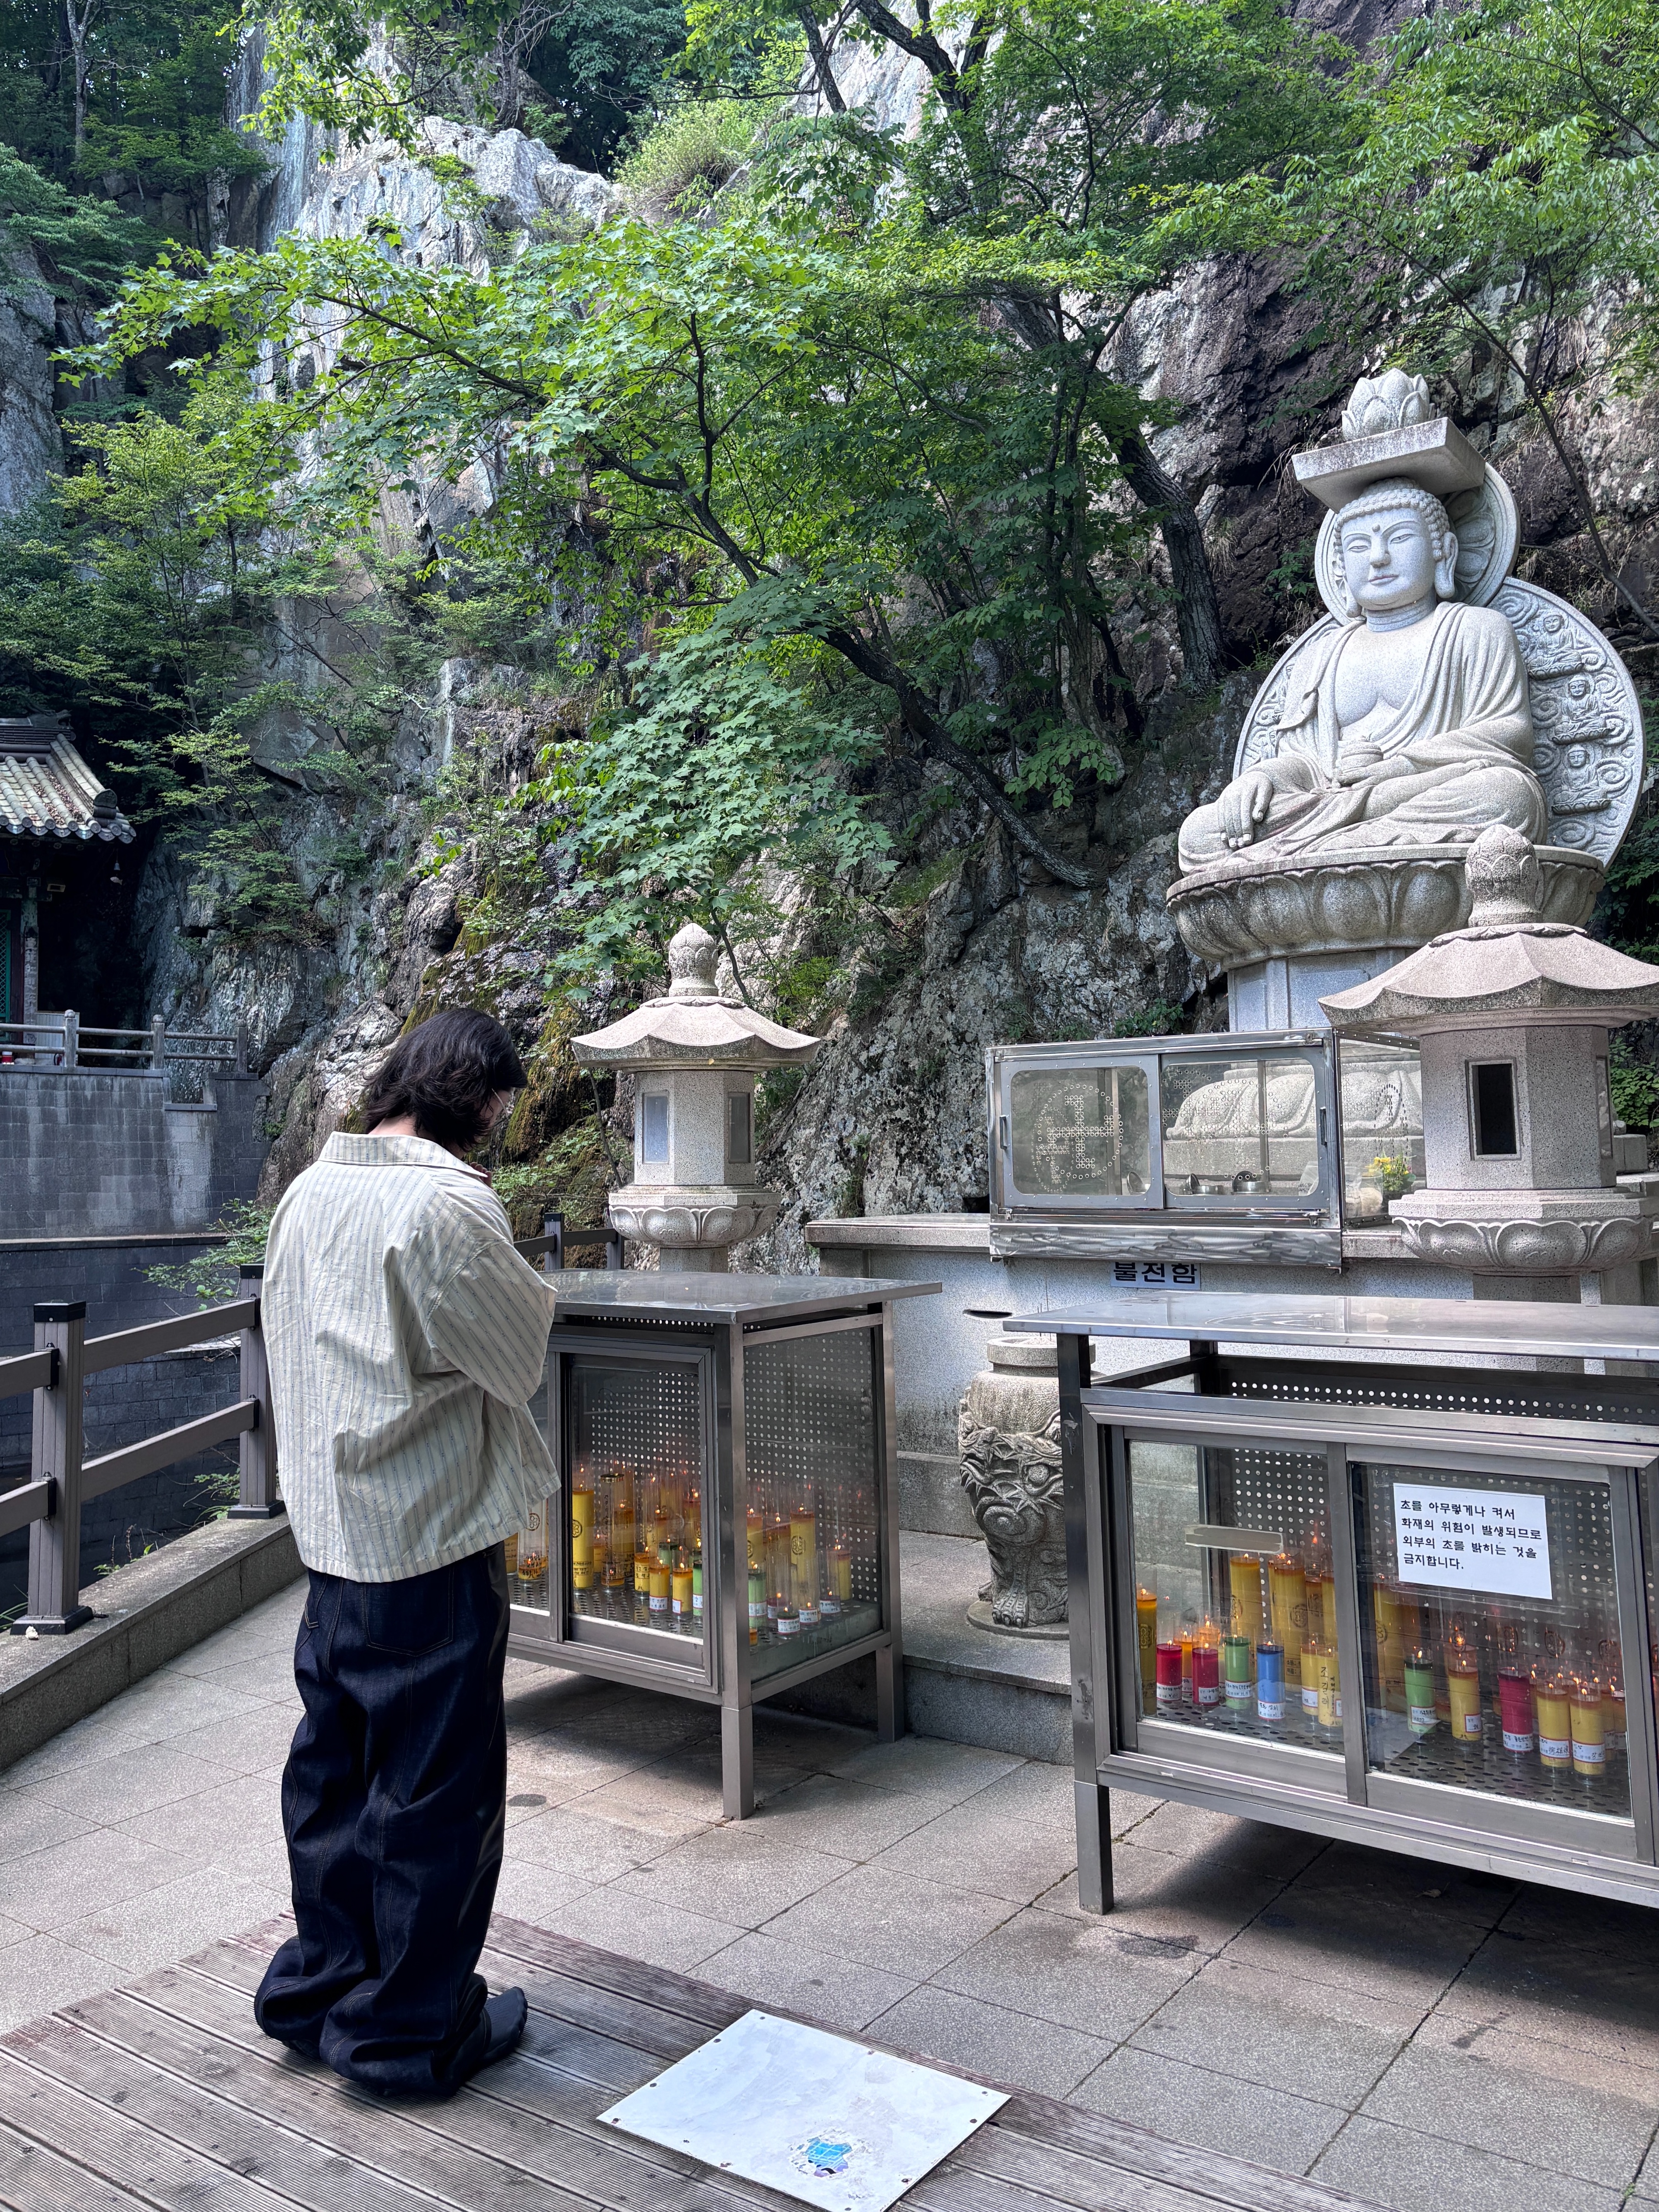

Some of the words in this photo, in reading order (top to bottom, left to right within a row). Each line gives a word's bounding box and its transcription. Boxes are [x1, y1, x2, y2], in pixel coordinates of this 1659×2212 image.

[1114, 1261, 1197, 1284] 불전함
[1401, 1500, 1422, 1511] 초를
[1429, 1502, 1485, 1517] 아무렇게나
[1492, 1507, 1515, 1520] 켜서
[1401, 1518, 1434, 1530] 화재의
[1441, 1521, 1474, 1535] 위험이
[1482, 1525, 1542, 1540] 발생되므로
[1403, 1536, 1435, 1549] 외부의
[1442, 1540, 1465, 1552] 초를
[1471, 1542, 1506, 1556] 밝히는
[1513, 1546, 1537, 1559] 것을
[1404, 1553, 1464, 1570] 금지합니다.
